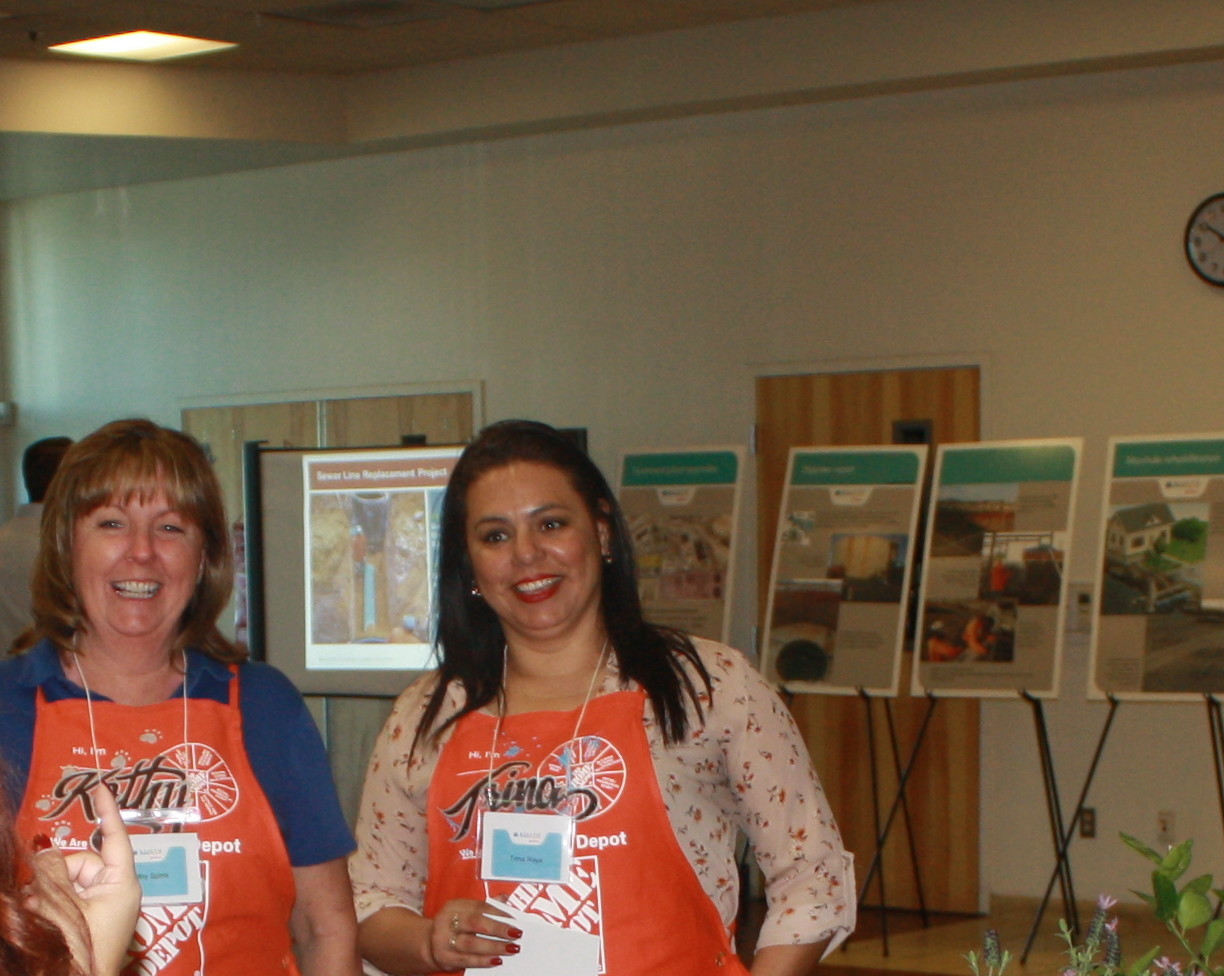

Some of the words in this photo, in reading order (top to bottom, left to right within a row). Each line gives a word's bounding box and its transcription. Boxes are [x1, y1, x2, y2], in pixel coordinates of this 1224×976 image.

[316, 470, 341, 481] Sewer
[343, 470, 361, 480] Line
[362, 469, 415, 481] Replacement
[418, 467, 448, 480] Project
[69, 838, 88, 848] Are
[200, 838, 241, 855] epot
[576, 831, 628, 850] Depot
